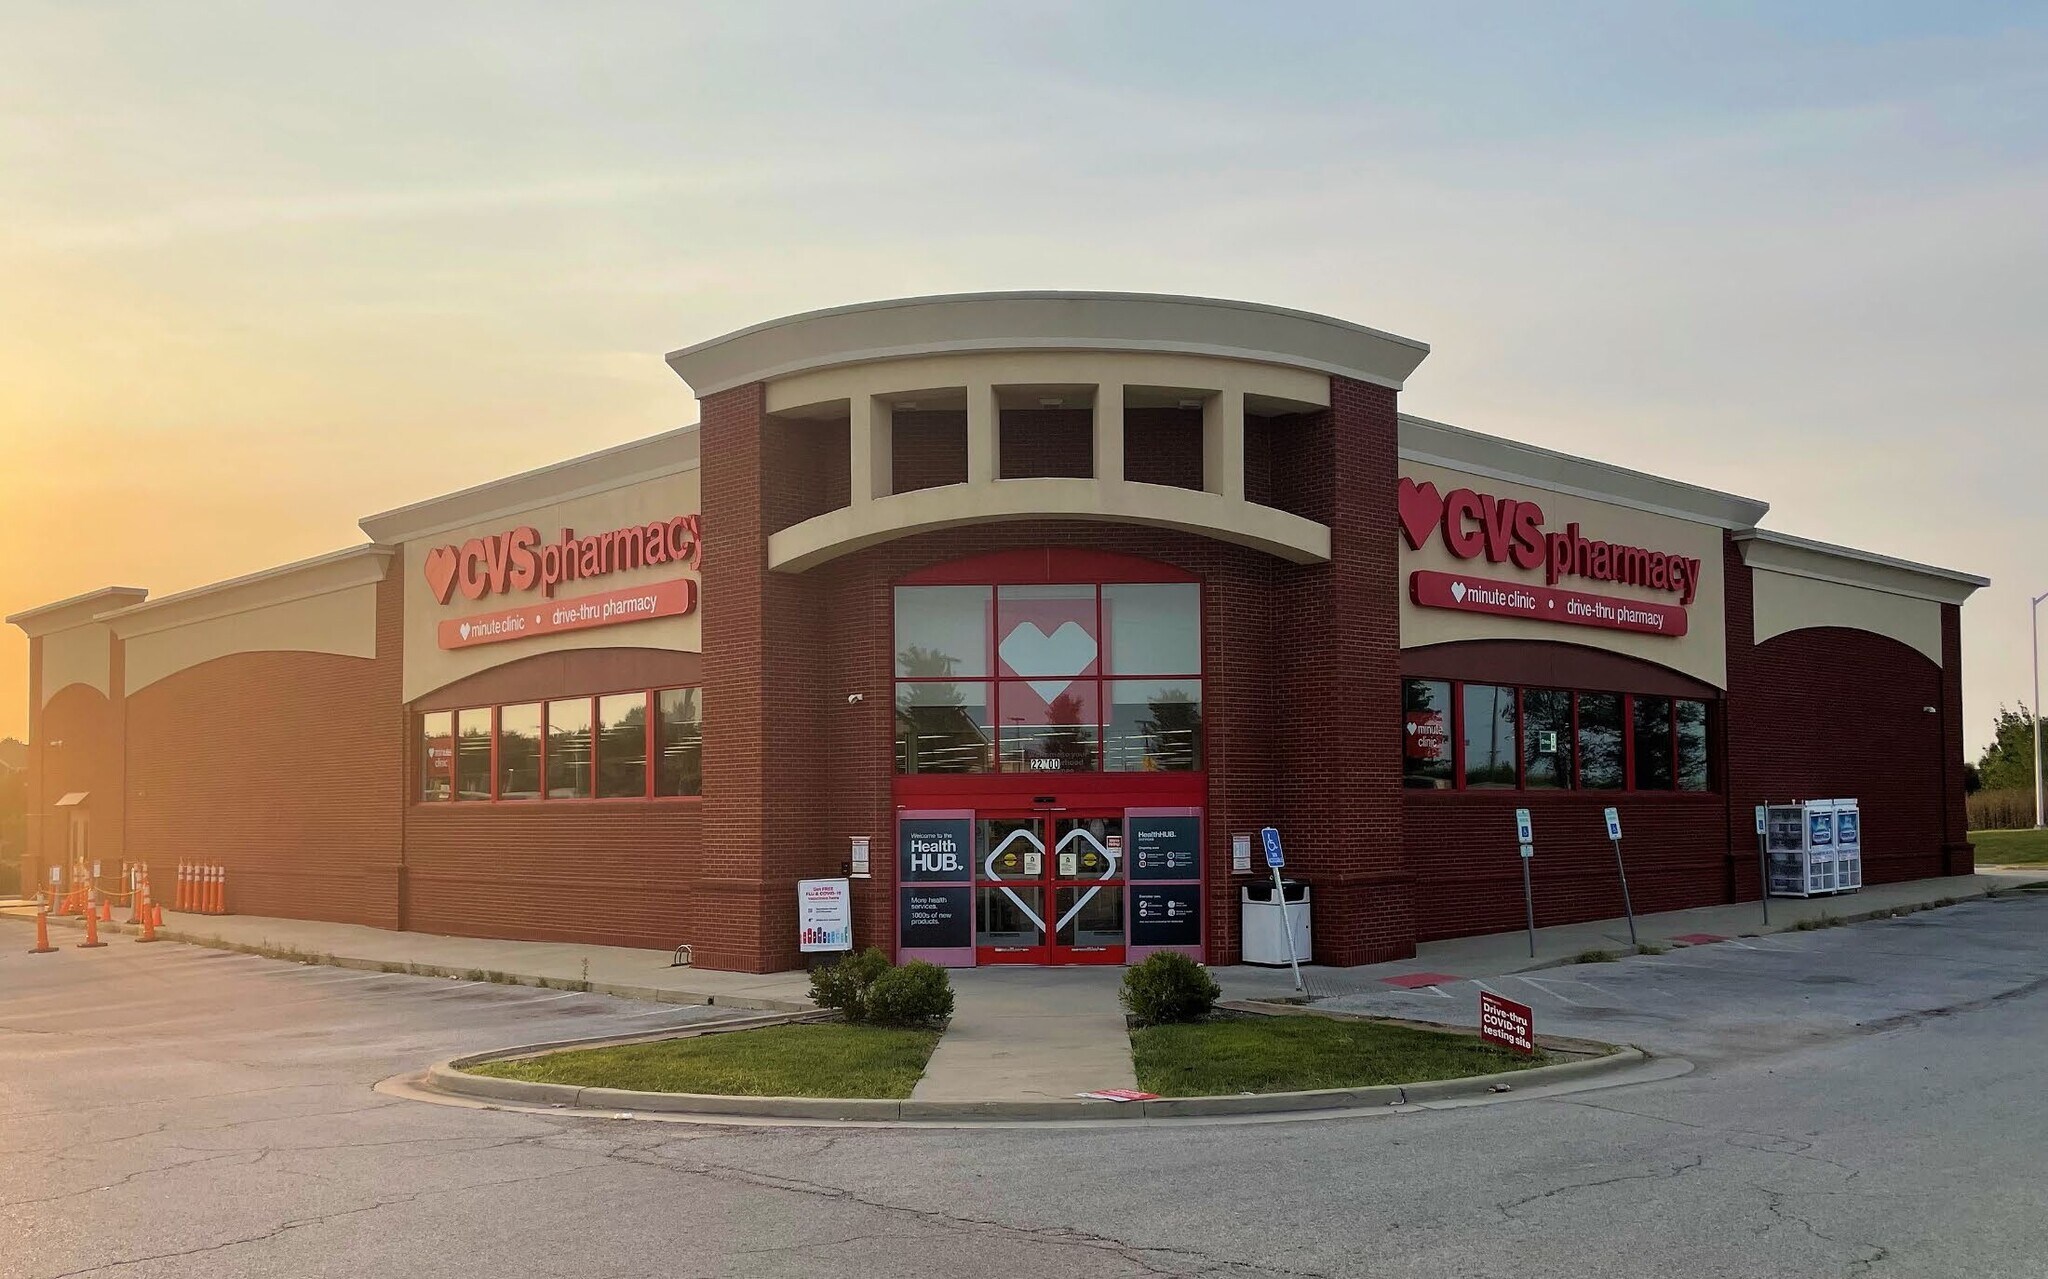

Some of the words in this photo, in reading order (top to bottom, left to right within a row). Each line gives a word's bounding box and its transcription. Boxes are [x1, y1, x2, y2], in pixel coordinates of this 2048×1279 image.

[1441, 488, 1545, 569] CVS
[1546, 523, 1700, 605] pharmacy
[459, 526, 541, 600] CVS
[471, 621, 501, 638] minute
[502, 615, 525, 633] clinic
[553, 604, 600, 625] drive-thru
[603, 595, 657, 621] pharmacy
[1468, 587, 1506, 606] minute
[1507, 591, 1536, 610] clinic
[1567, 601, 1615, 620] drive-thru
[1617, 608, 1664, 630] pharmacy
[1418, 724, 1443, 735] minute
[911, 839, 957, 852] Health
[1483, 1002, 1528, 1027] Drive-thru
[1483, 1013, 1526, 1036] COVID-19
[1483, 1025, 1514, 1044] testing
[1515, 1036, 1531, 1049] site
